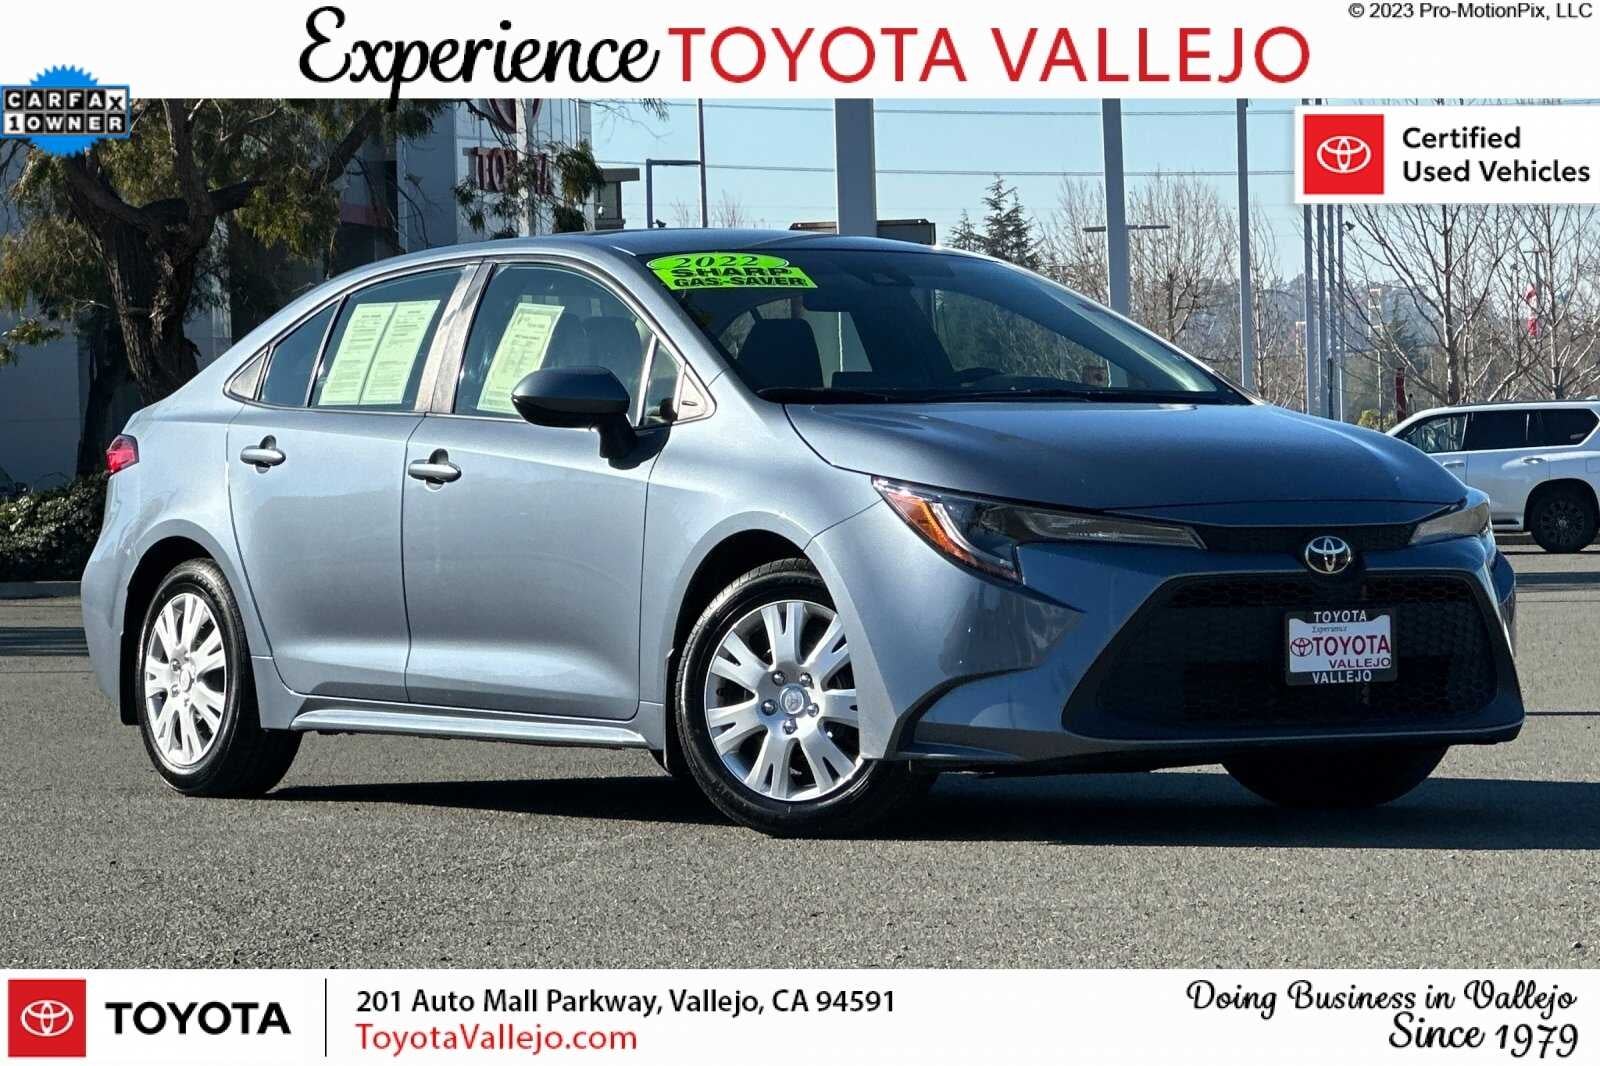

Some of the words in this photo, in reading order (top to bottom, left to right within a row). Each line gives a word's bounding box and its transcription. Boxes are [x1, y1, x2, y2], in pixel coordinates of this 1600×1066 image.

[673, 256, 758, 268] 2022
[671, 266, 792, 278] SHARP
[1313, 610, 1367, 623] TOYOTA
[1312, 635, 1391, 656] TOYOTA
[1328, 657, 1391, 669] VALLEJO
[1312, 670, 1372, 684] VALLEJO
